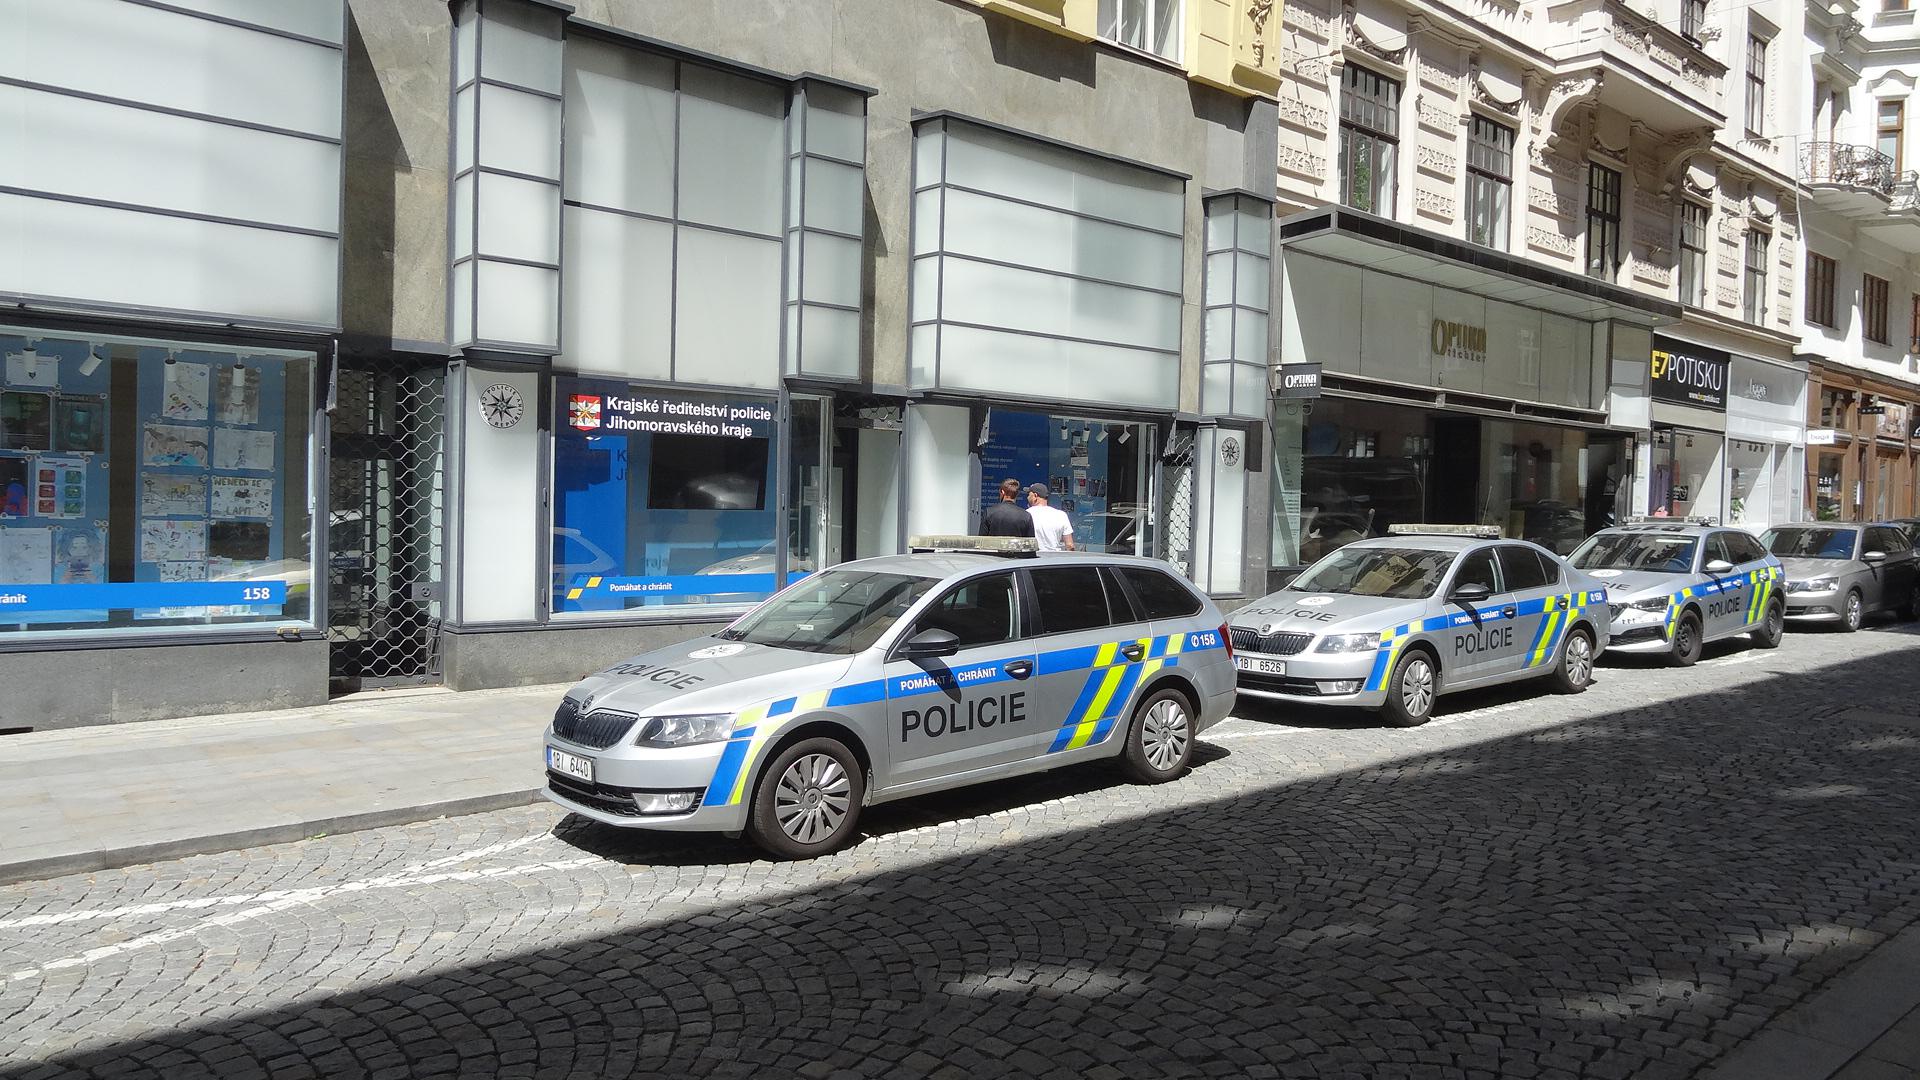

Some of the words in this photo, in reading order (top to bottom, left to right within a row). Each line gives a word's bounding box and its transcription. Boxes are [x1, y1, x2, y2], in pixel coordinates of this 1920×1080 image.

[1431, 319, 1487, 355] OPTIKA
[1285, 374, 1317, 388] OPTIKA
[606, 396, 660, 414] Krajské
[663, 399, 728, 418] ředitelství
[730, 407, 771, 421] policie
[606, 415, 719, 435] Jihomoravského
[722, 422, 752, 439] kraje
[243, 587, 271, 600] 158
[609, 583, 641, 592] Pomáhat
[648, 582, 672, 591] chránit
[1242, 608, 1337, 622] POLICIE
[1708, 597, 1741, 620] POLICIE
[1200, 633, 1216, 646] 158
[1455, 627, 1513, 656] POLICIE
[604, 663, 705, 690] POLICIE
[1260, 660, 1281, 673] 6526
[900, 675, 946, 691] POMÁHAT
[957, 667, 997, 682] CHRÁNIT
[901, 691, 1026, 743] POLICIE
[570, 757, 589, 777] 6440
